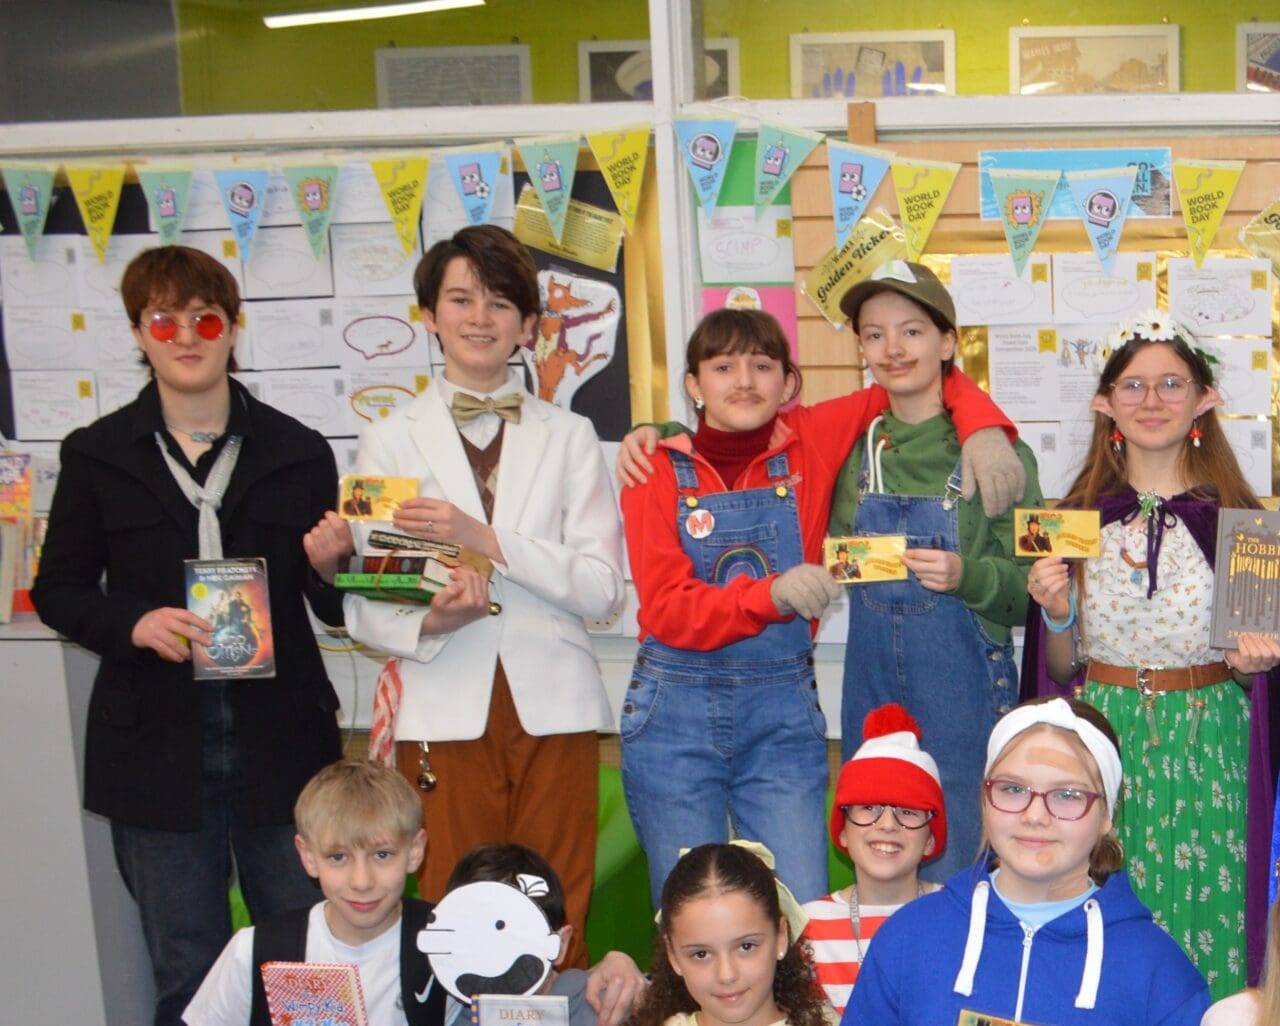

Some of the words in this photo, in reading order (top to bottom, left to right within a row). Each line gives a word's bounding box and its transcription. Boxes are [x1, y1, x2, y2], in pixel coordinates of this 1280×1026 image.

[607, 152, 639, 173] WORLD
[611, 165, 636, 181] BOOK
[387, 180, 419, 199] WORLD
[615, 177, 632, 189] DAY
[391, 192, 417, 207] BOOK
[904, 190, 940, 205] WORLD
[1186, 190, 1224, 206] WORLD
[394, 203, 410, 215] DAY
[906, 201, 935, 213] BOOK
[1189, 201, 1219, 215] BOOK
[908, 211, 928, 222] DAY
[1191, 212, 1210, 224] DAY
[816, 260, 854, 303] Golden
[852, 229, 894, 260] Ticke
[688, 516, 714, 534] M
[281, 1000, 320, 1014] Wimpy
[323, 999, 344, 1013] Kid
[498, 1008, 545, 1021] DIARY
